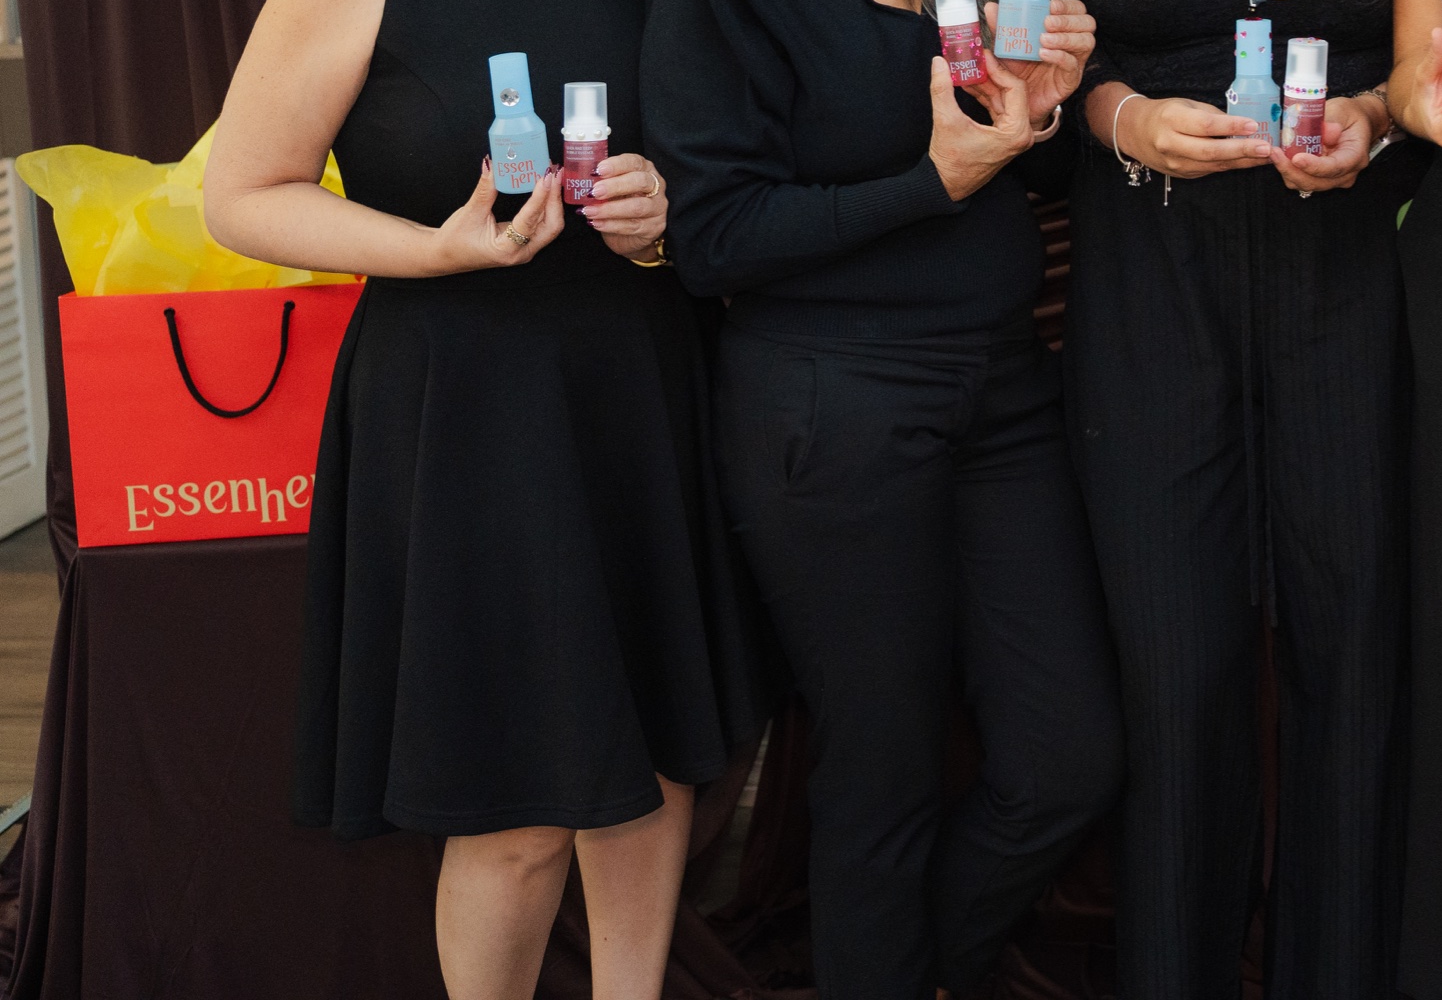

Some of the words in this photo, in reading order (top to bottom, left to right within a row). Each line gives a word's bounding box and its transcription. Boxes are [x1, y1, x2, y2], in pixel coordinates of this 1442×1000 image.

[997, 25, 1028, 40] Essen
[1004, 37, 1033, 55] herb
[950, 59, 977, 74] Essen
[497, 159, 534, 177] Essen
[566, 178, 593, 190] Essen
[124, 473, 316, 532] Essenhe
